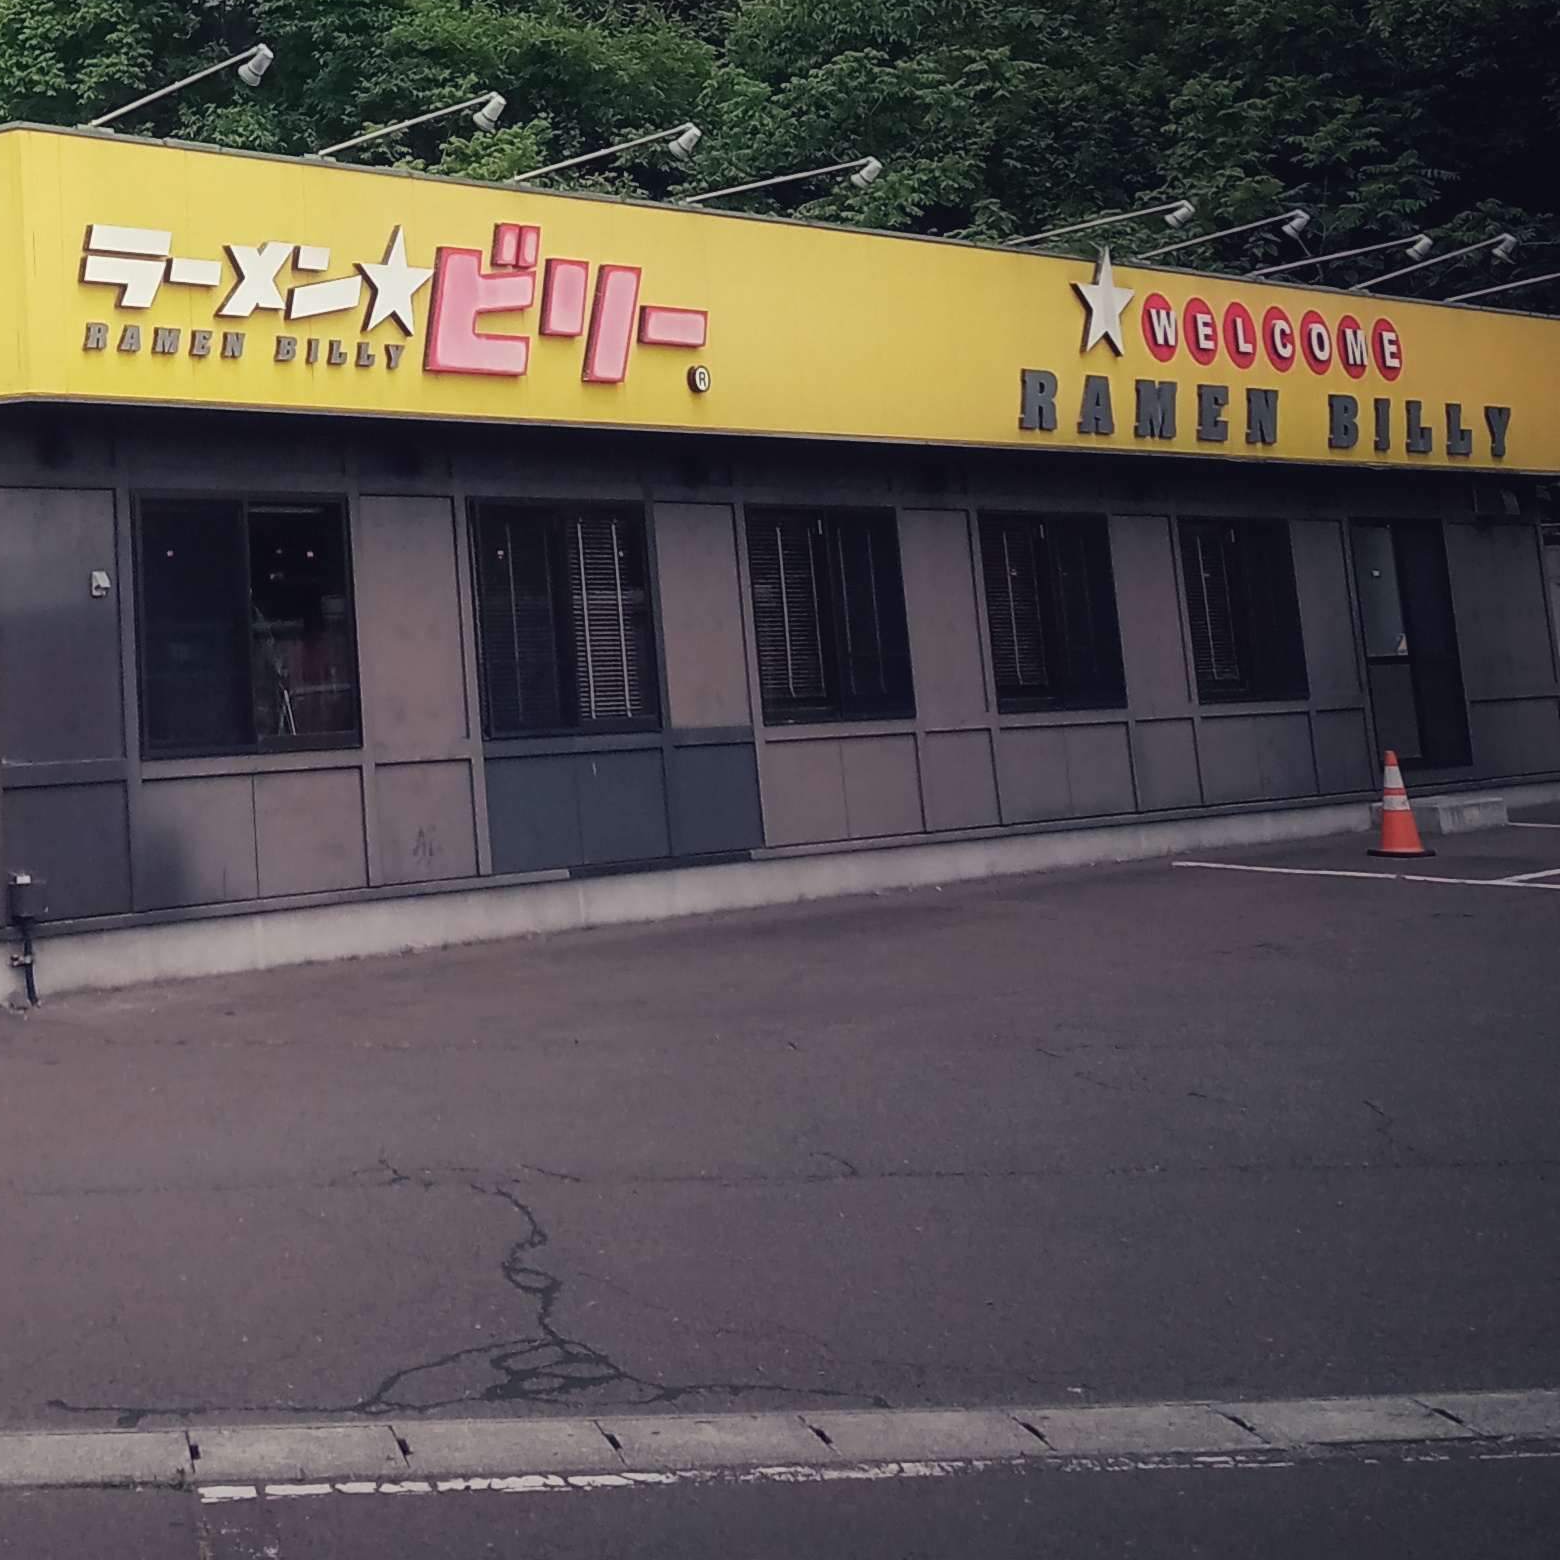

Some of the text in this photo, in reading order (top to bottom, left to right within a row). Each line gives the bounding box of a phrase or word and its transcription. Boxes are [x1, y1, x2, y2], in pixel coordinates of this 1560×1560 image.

[79, 222, 708, 383] ラーメン ビリー
[1146, 307, 1401, 368] WELCOME
[84, 321, 406, 369] RAMEN BILLY
[1019, 368, 1512, 458] RAMEN BILLY
